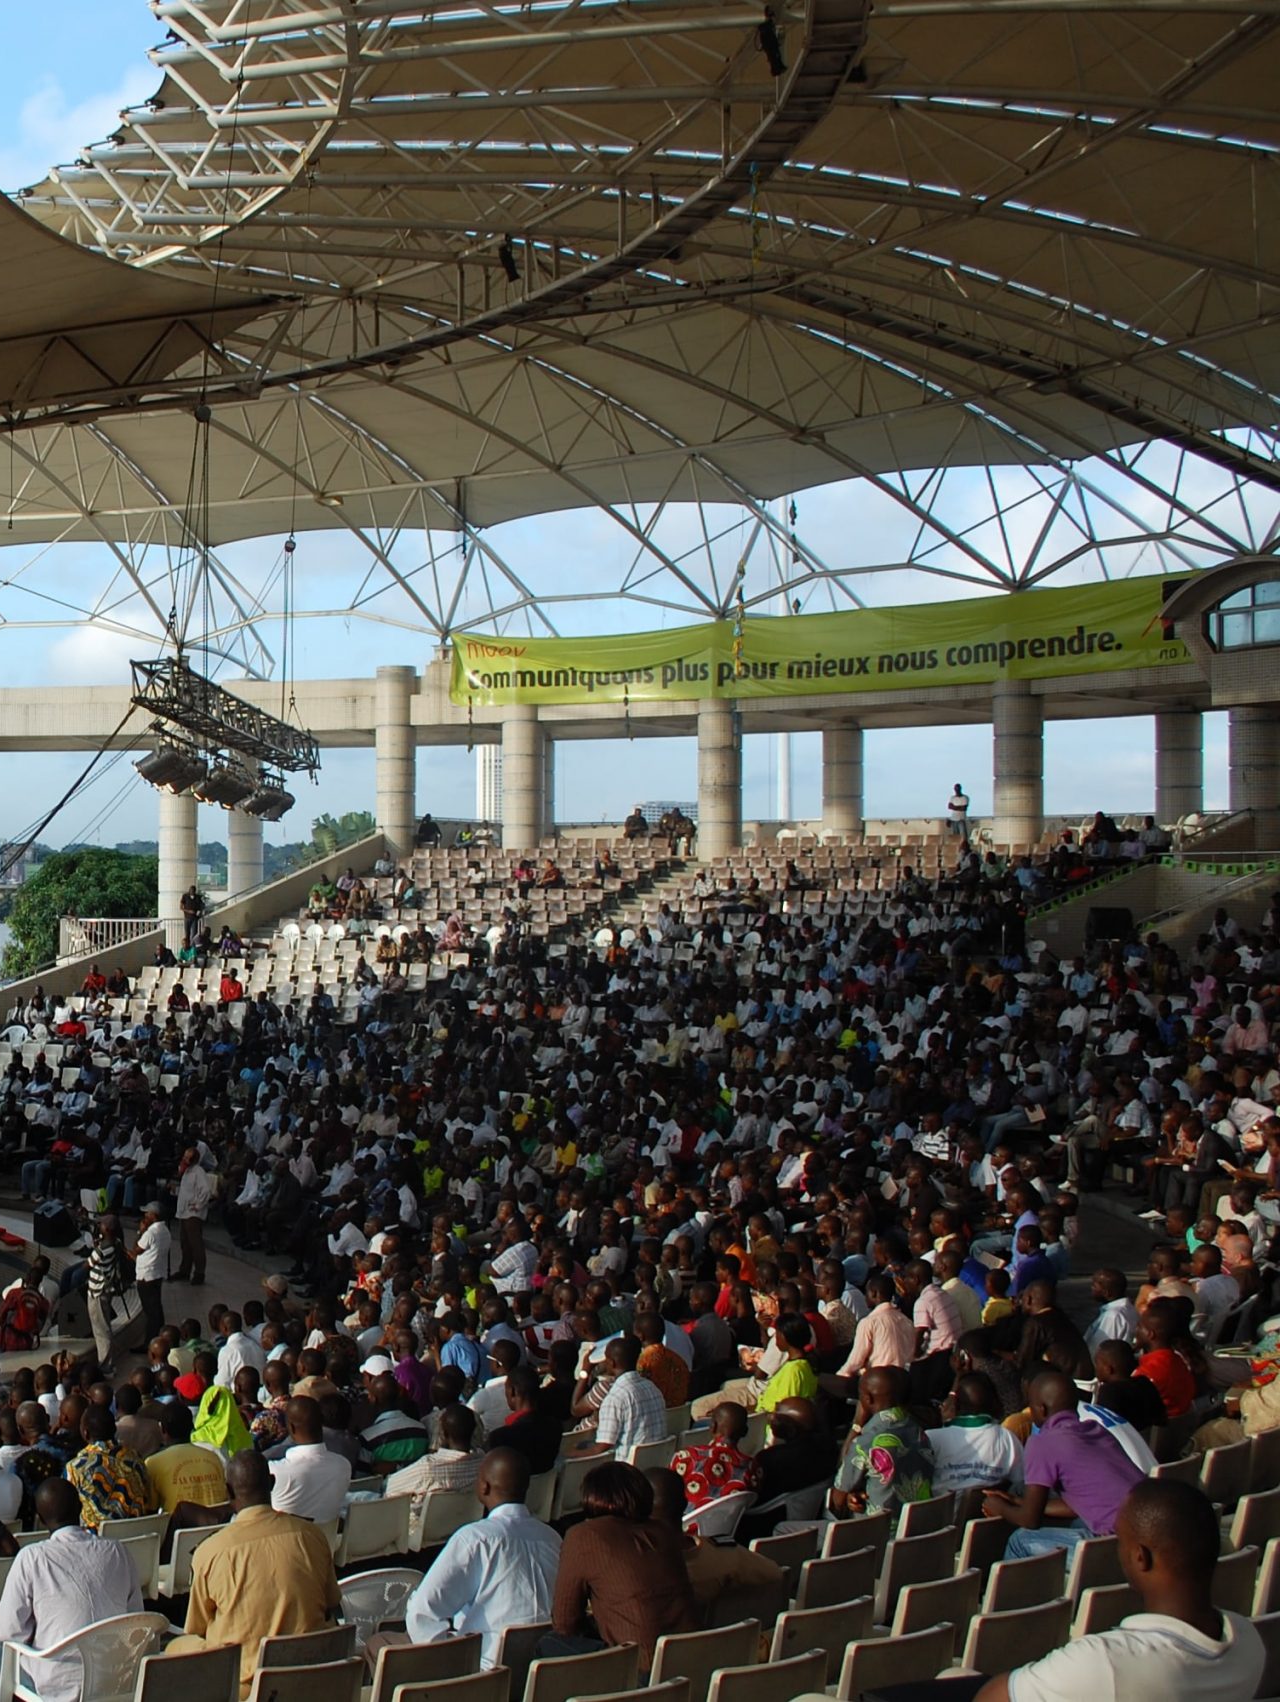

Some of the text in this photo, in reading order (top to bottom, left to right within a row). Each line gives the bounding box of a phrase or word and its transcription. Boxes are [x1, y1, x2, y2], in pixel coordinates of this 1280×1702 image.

[662, 657, 709, 690] plus
[717, 653, 780, 688] pour
[787, 652, 871, 679] mieux
[878, 650, 938, 673] nous
[946, 625, 1123, 668] comprendre.
